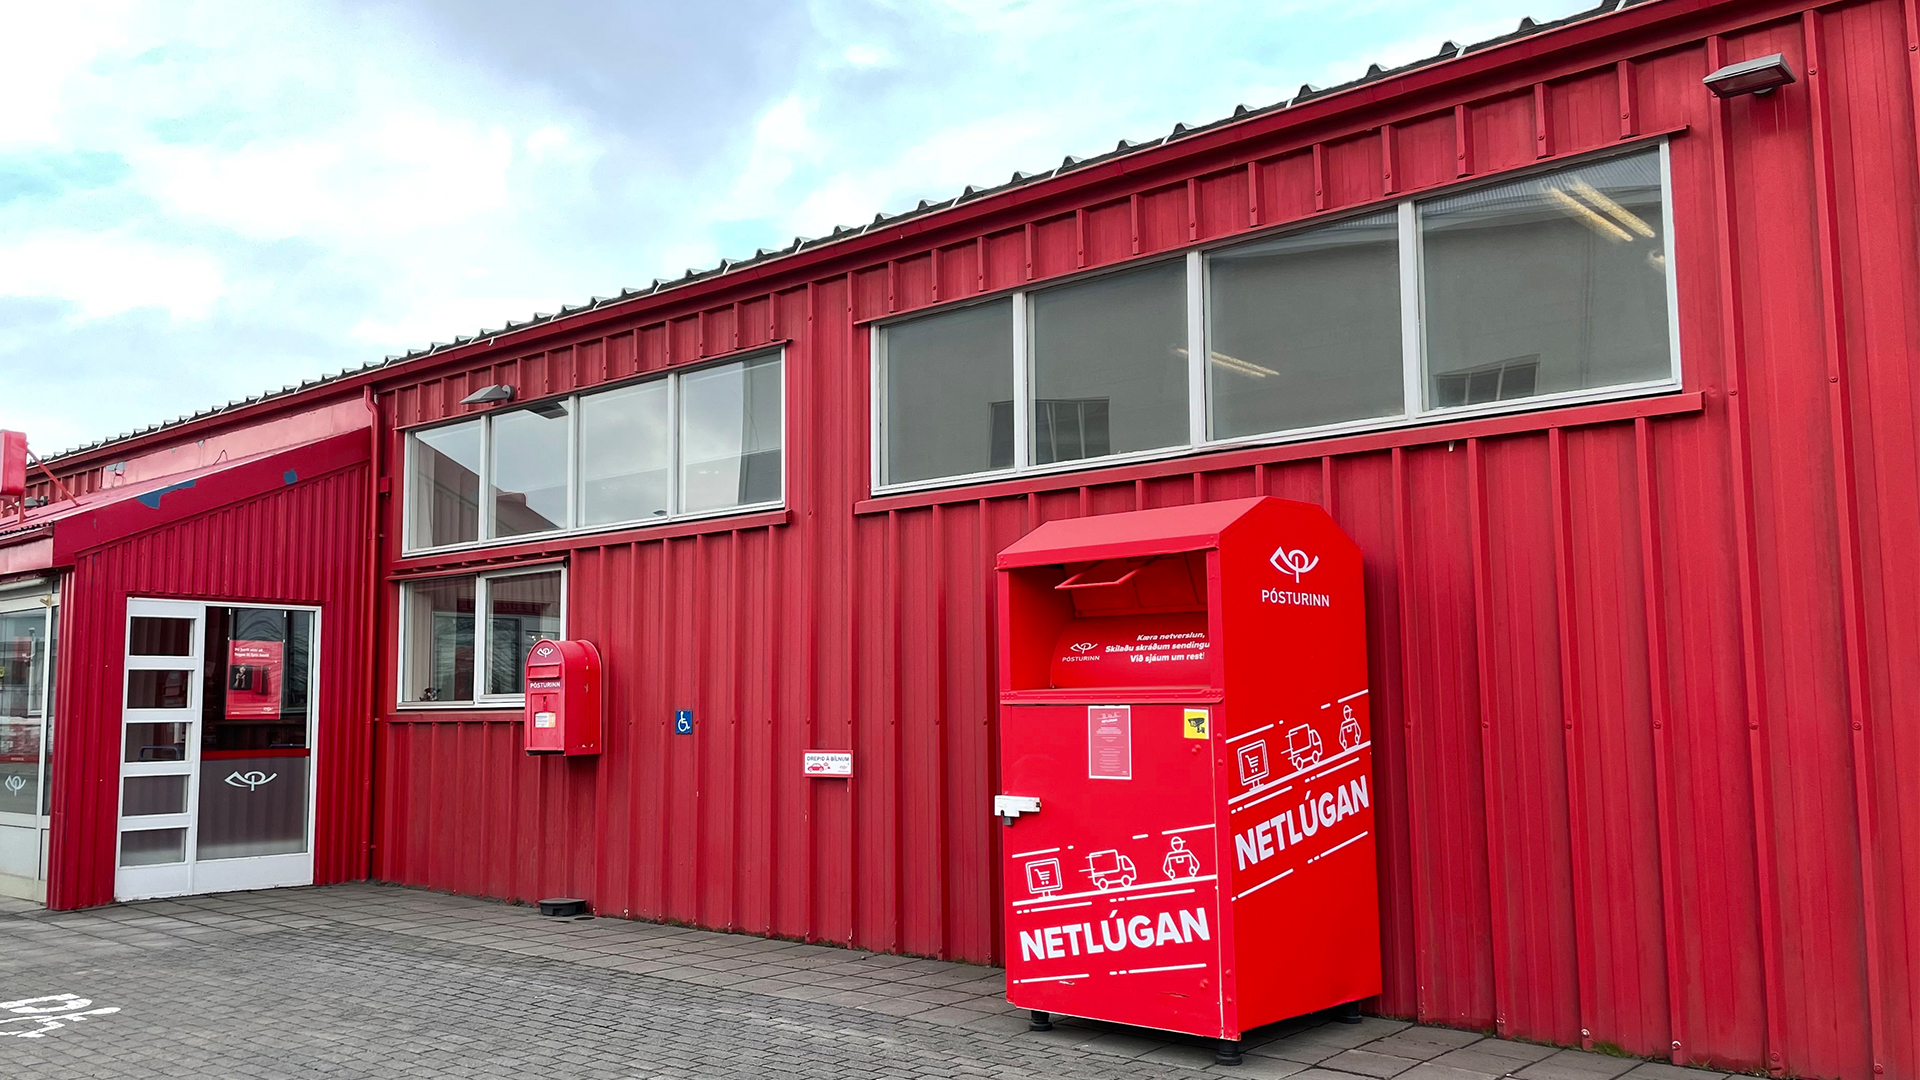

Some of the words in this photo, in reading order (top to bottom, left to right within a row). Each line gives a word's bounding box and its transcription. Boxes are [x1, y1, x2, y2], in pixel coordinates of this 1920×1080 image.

[1261, 587, 1330, 607] PÓSTURINN
[1136, 633, 1158, 641] Kæra
[1159, 631, 1206, 640] netverslun,
[1105, 644, 1134, 653] Skilaðu
[1135, 642, 1170, 652] skráðum
[1130, 653, 1144, 663] Við
[1145, 653, 1170, 664] sjáum
[1234, 775, 1370, 871] NETLÚGAN
[1019, 907, 1210, 962] NETLÚGAN
